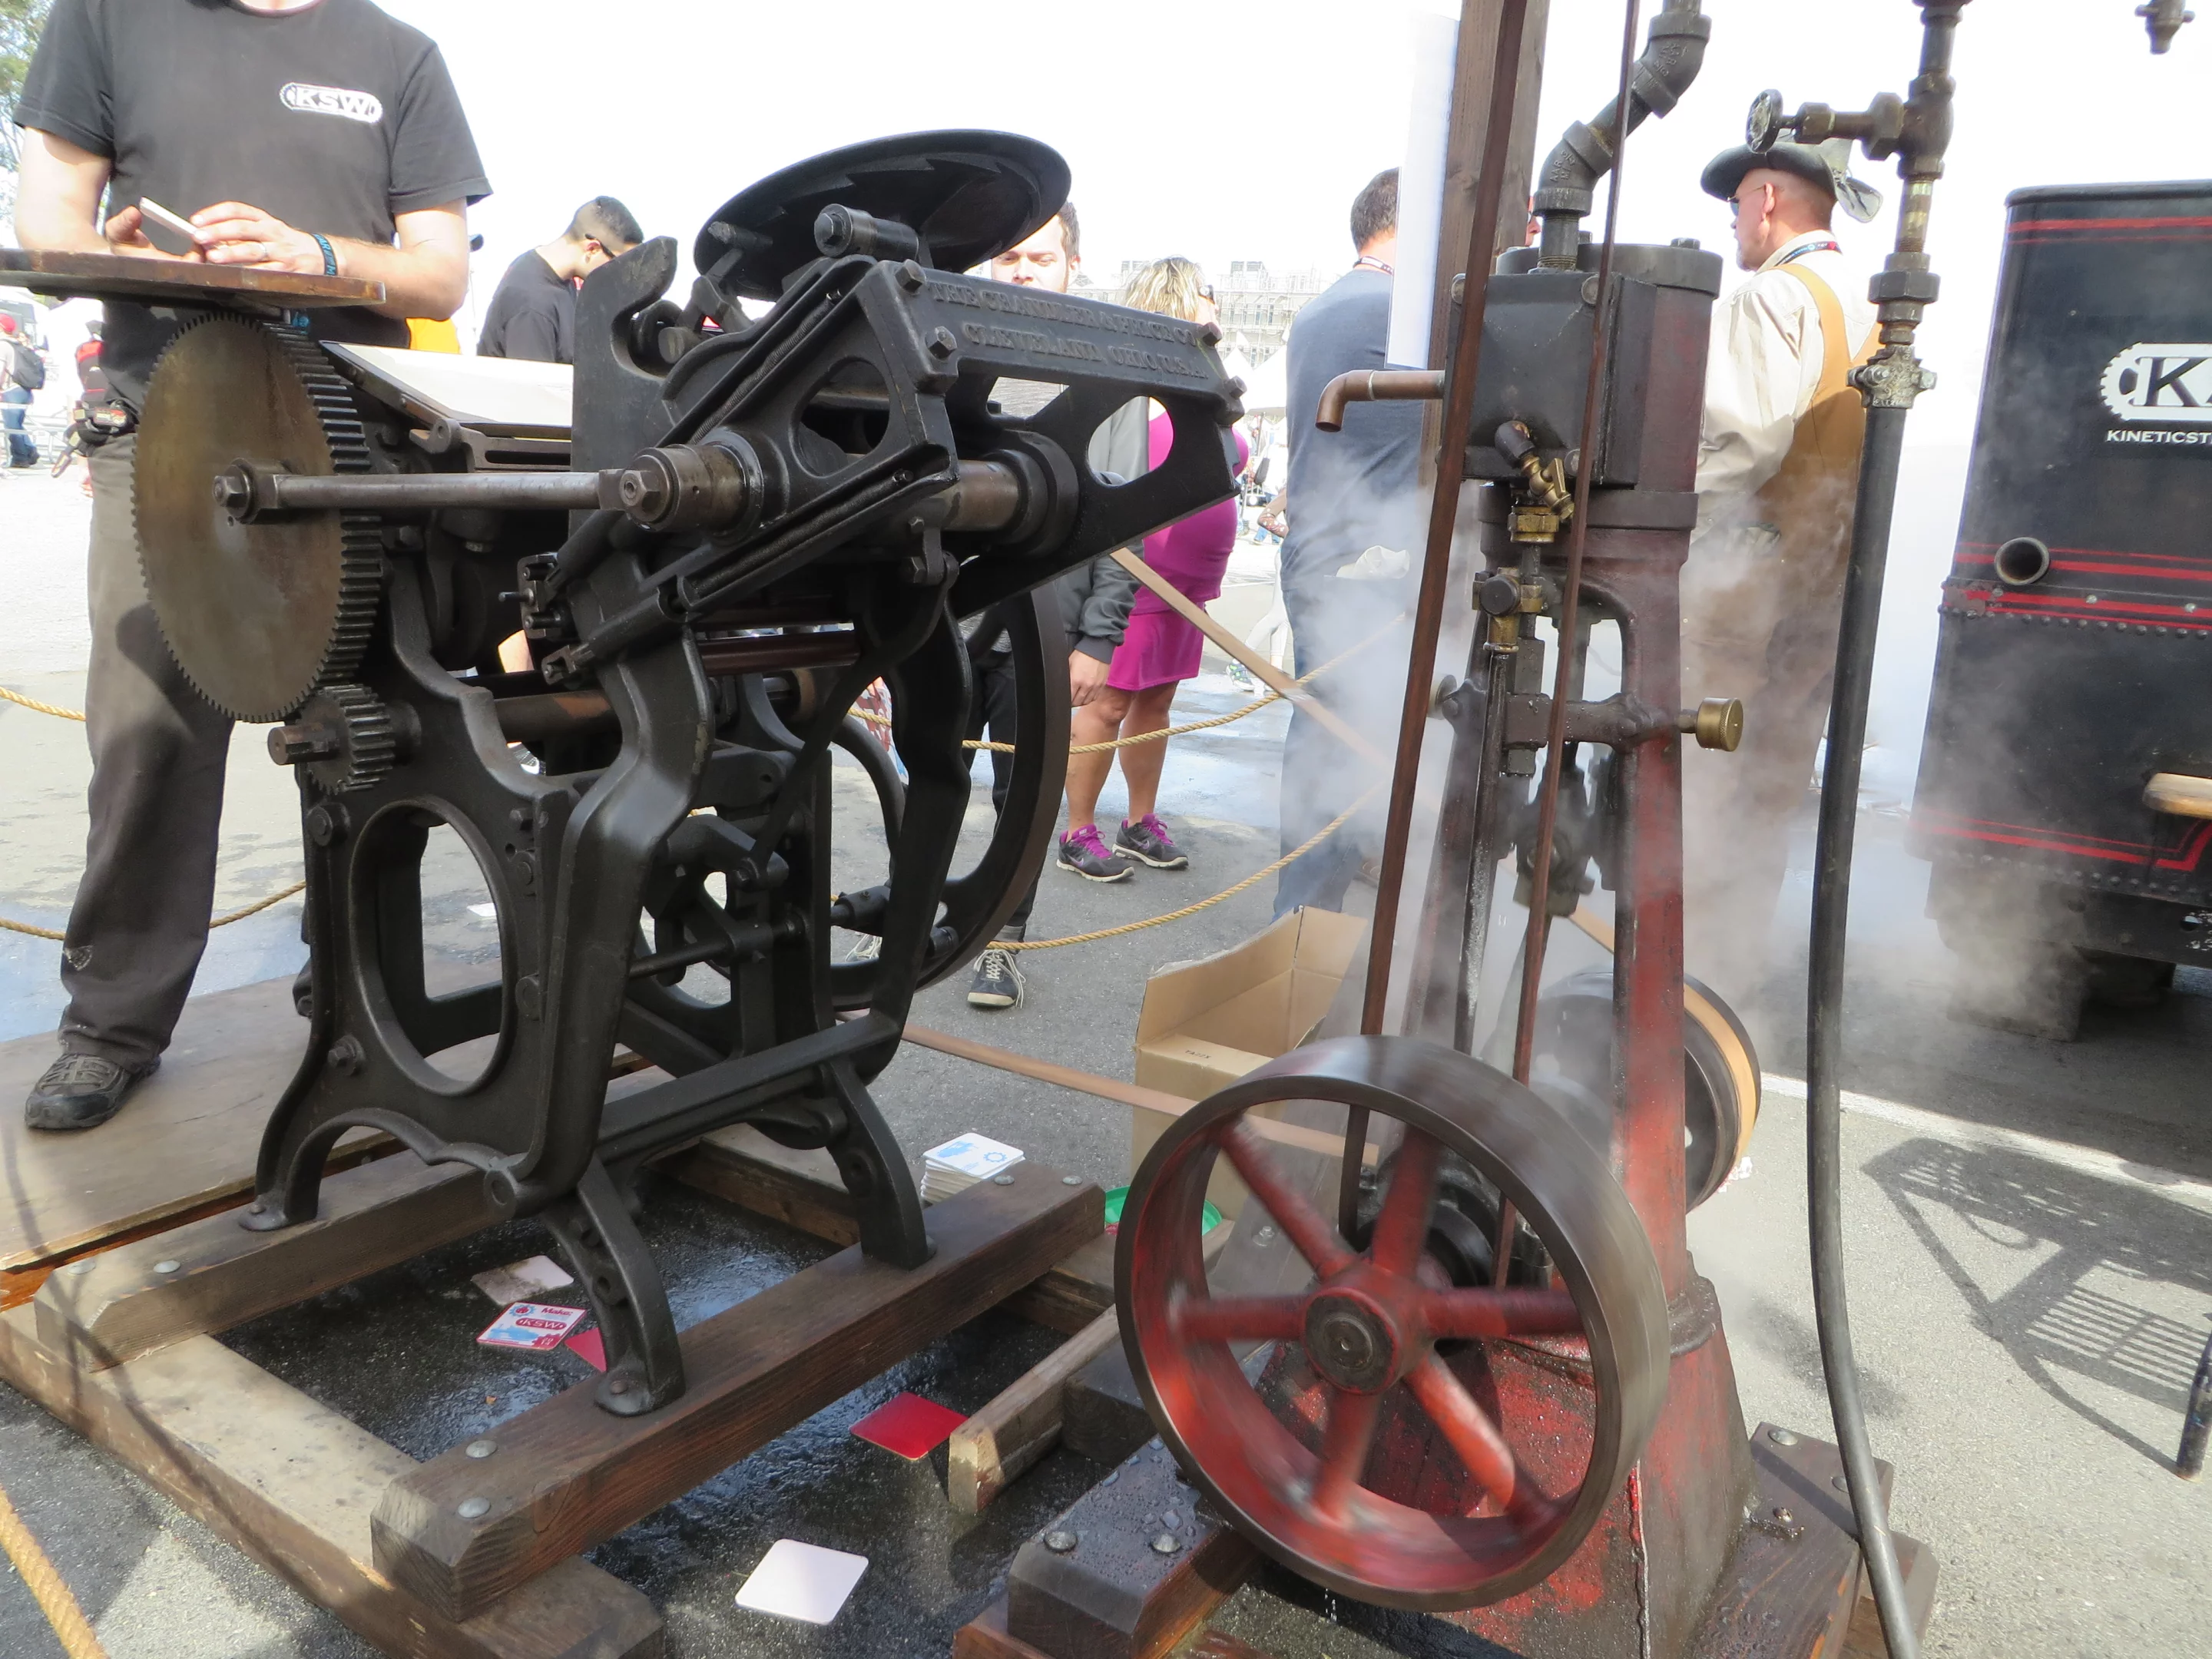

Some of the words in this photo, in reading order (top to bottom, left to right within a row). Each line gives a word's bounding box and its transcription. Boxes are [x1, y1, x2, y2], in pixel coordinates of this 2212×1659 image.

[296, 86, 372, 116] KSW
[927, 280, 981, 308] THE
[979, 289, 1100, 330] CHANDLER
[1112, 313, 1175, 343] PRICE
[2106, 429, 2212, 445] KINETICST
[522, 1318, 559, 1329] KSW
